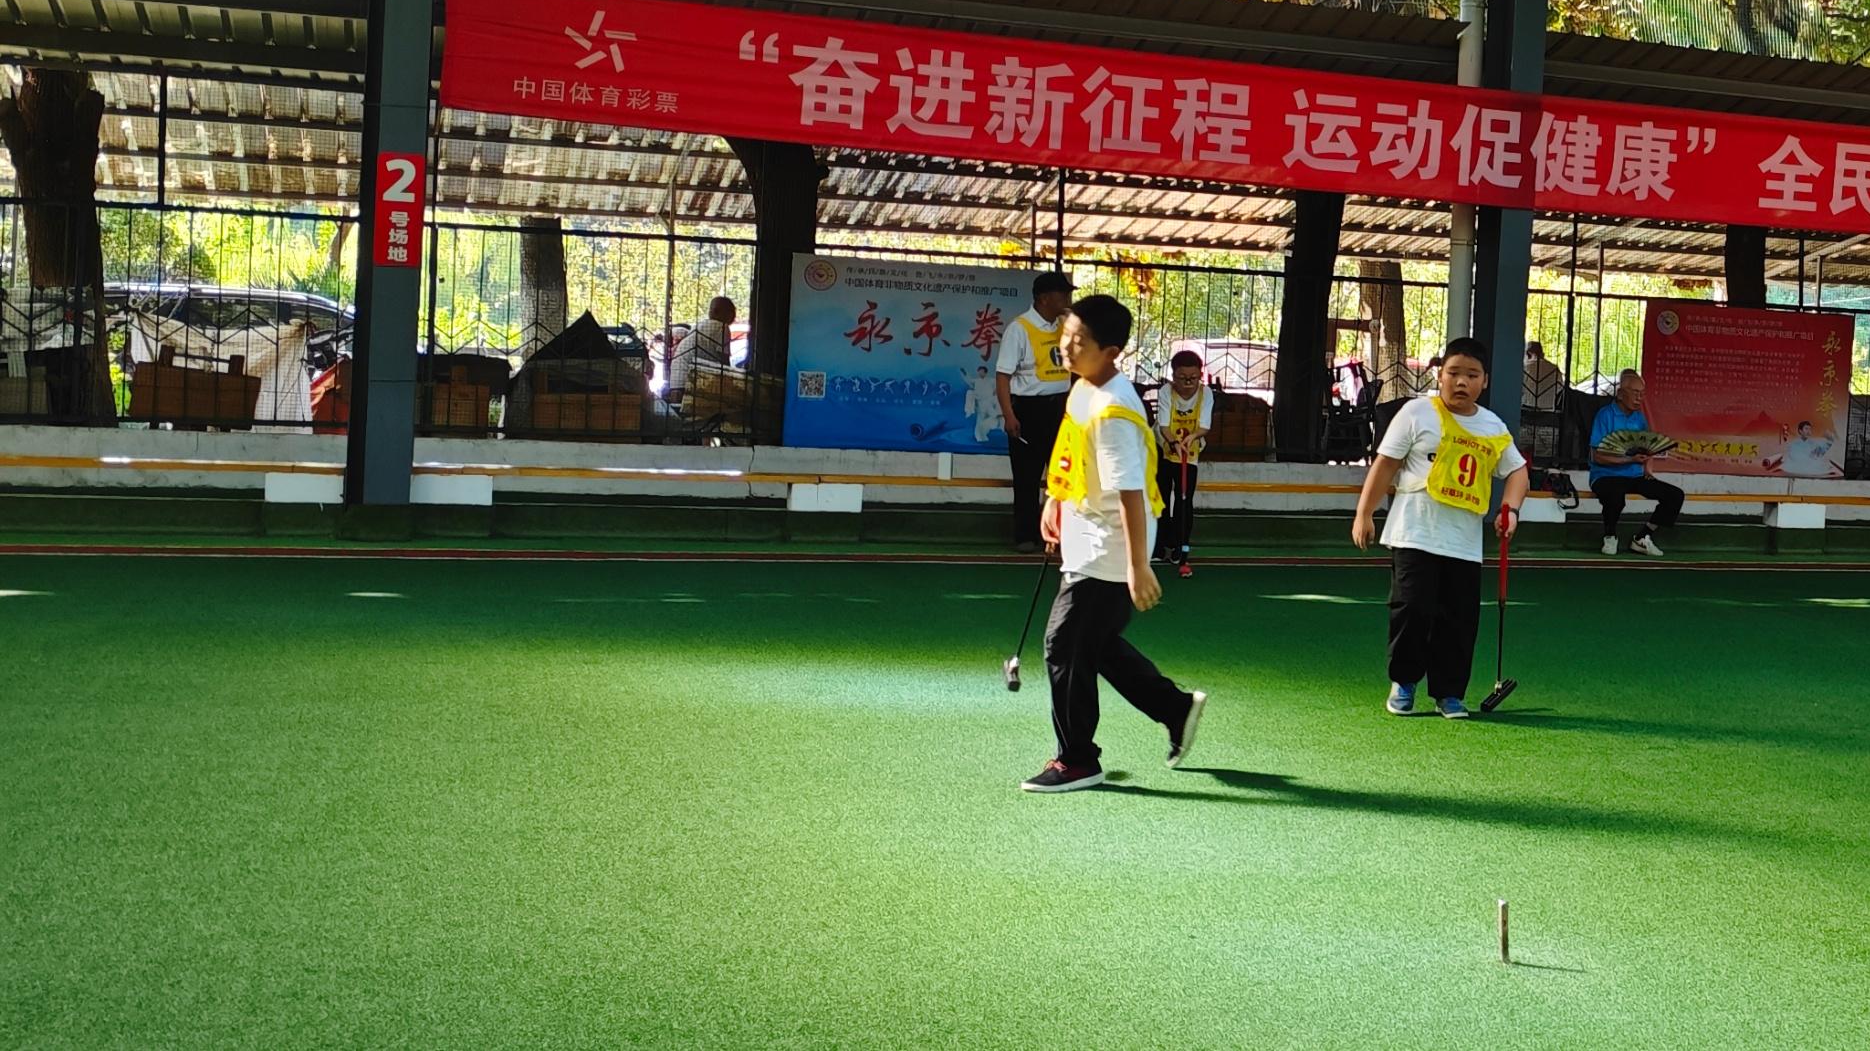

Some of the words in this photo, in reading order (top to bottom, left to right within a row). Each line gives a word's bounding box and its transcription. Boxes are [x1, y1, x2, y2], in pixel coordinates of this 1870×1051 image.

[512, 75, 680, 114] 中国体育彩票
[382, 158, 416, 203] 2
[387, 211, 410, 263] 号场地
[1458, 453, 1478, 488] 9
